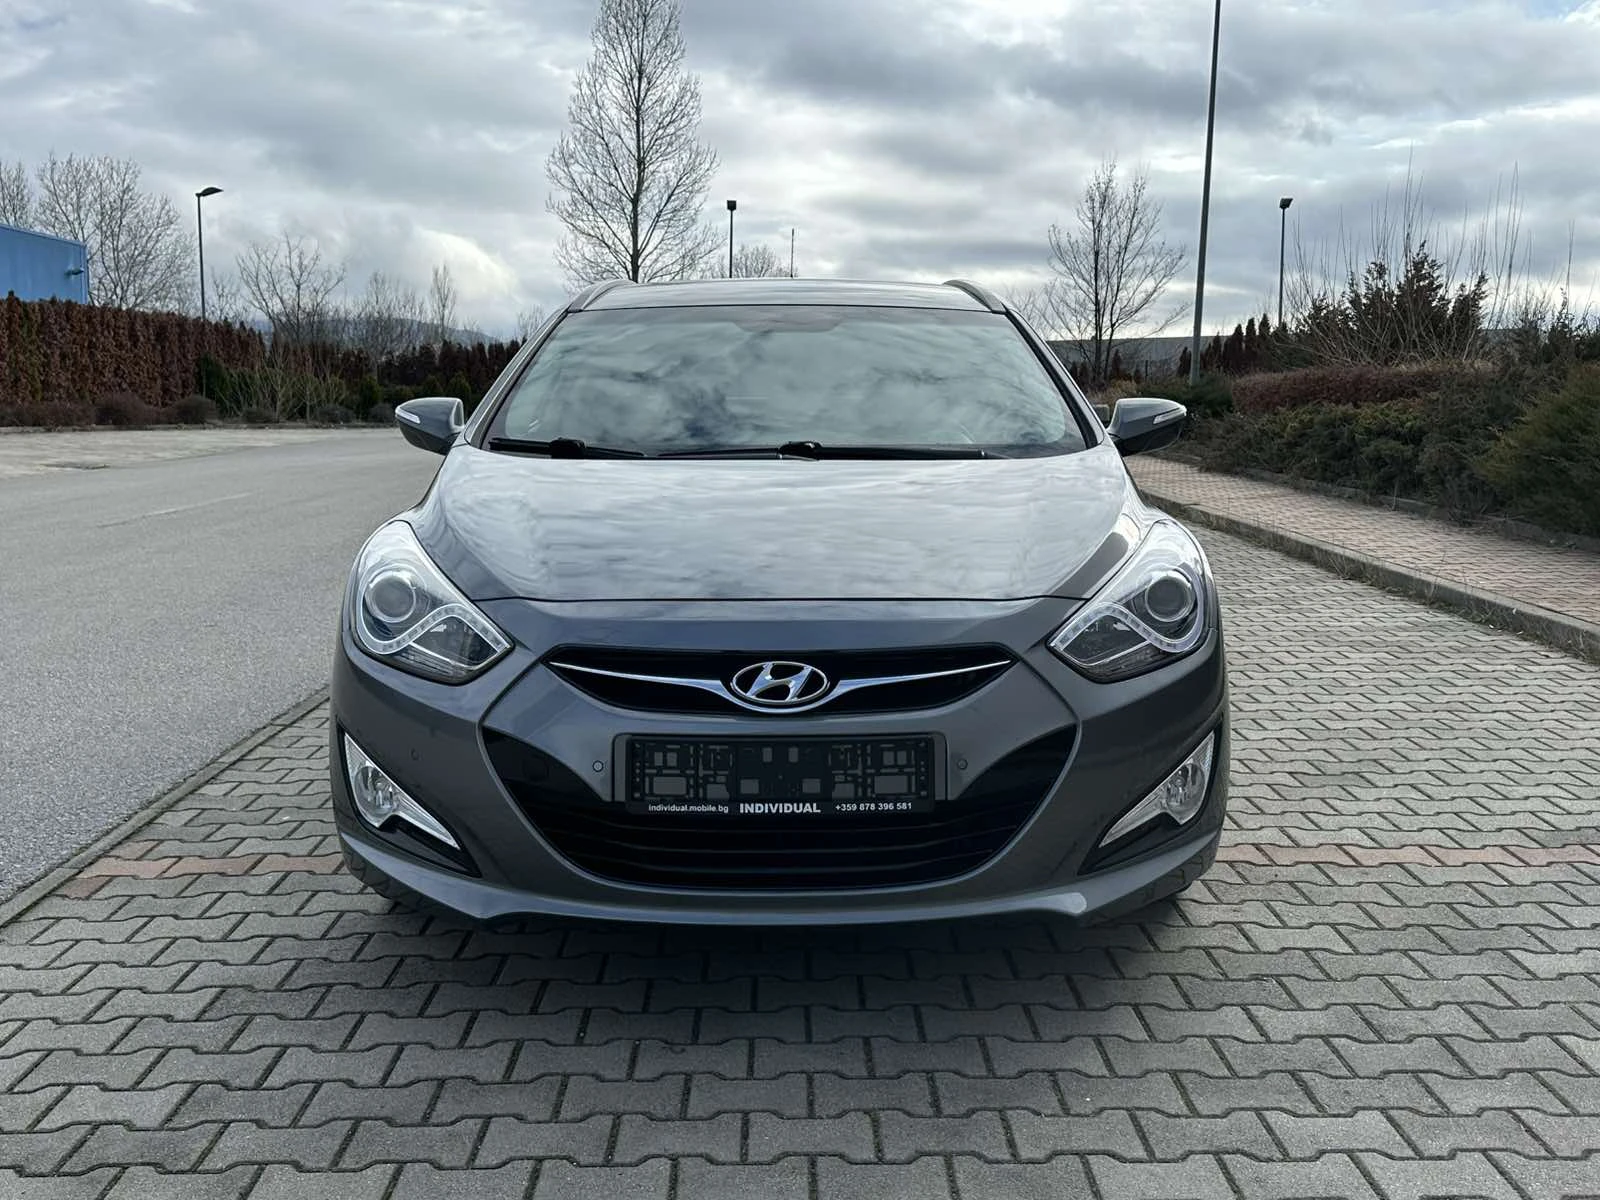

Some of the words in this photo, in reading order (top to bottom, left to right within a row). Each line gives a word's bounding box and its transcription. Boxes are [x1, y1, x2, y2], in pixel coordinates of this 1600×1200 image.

[648, 803, 729, 814] individual.mobile.bg
[739, 802, 821, 814] INDIVIDUAL
[835, 803, 857, 812] +359
[859, 803, 876, 811] 878
[878, 802, 895, 811] 396
[896, 802, 912, 811] 581
